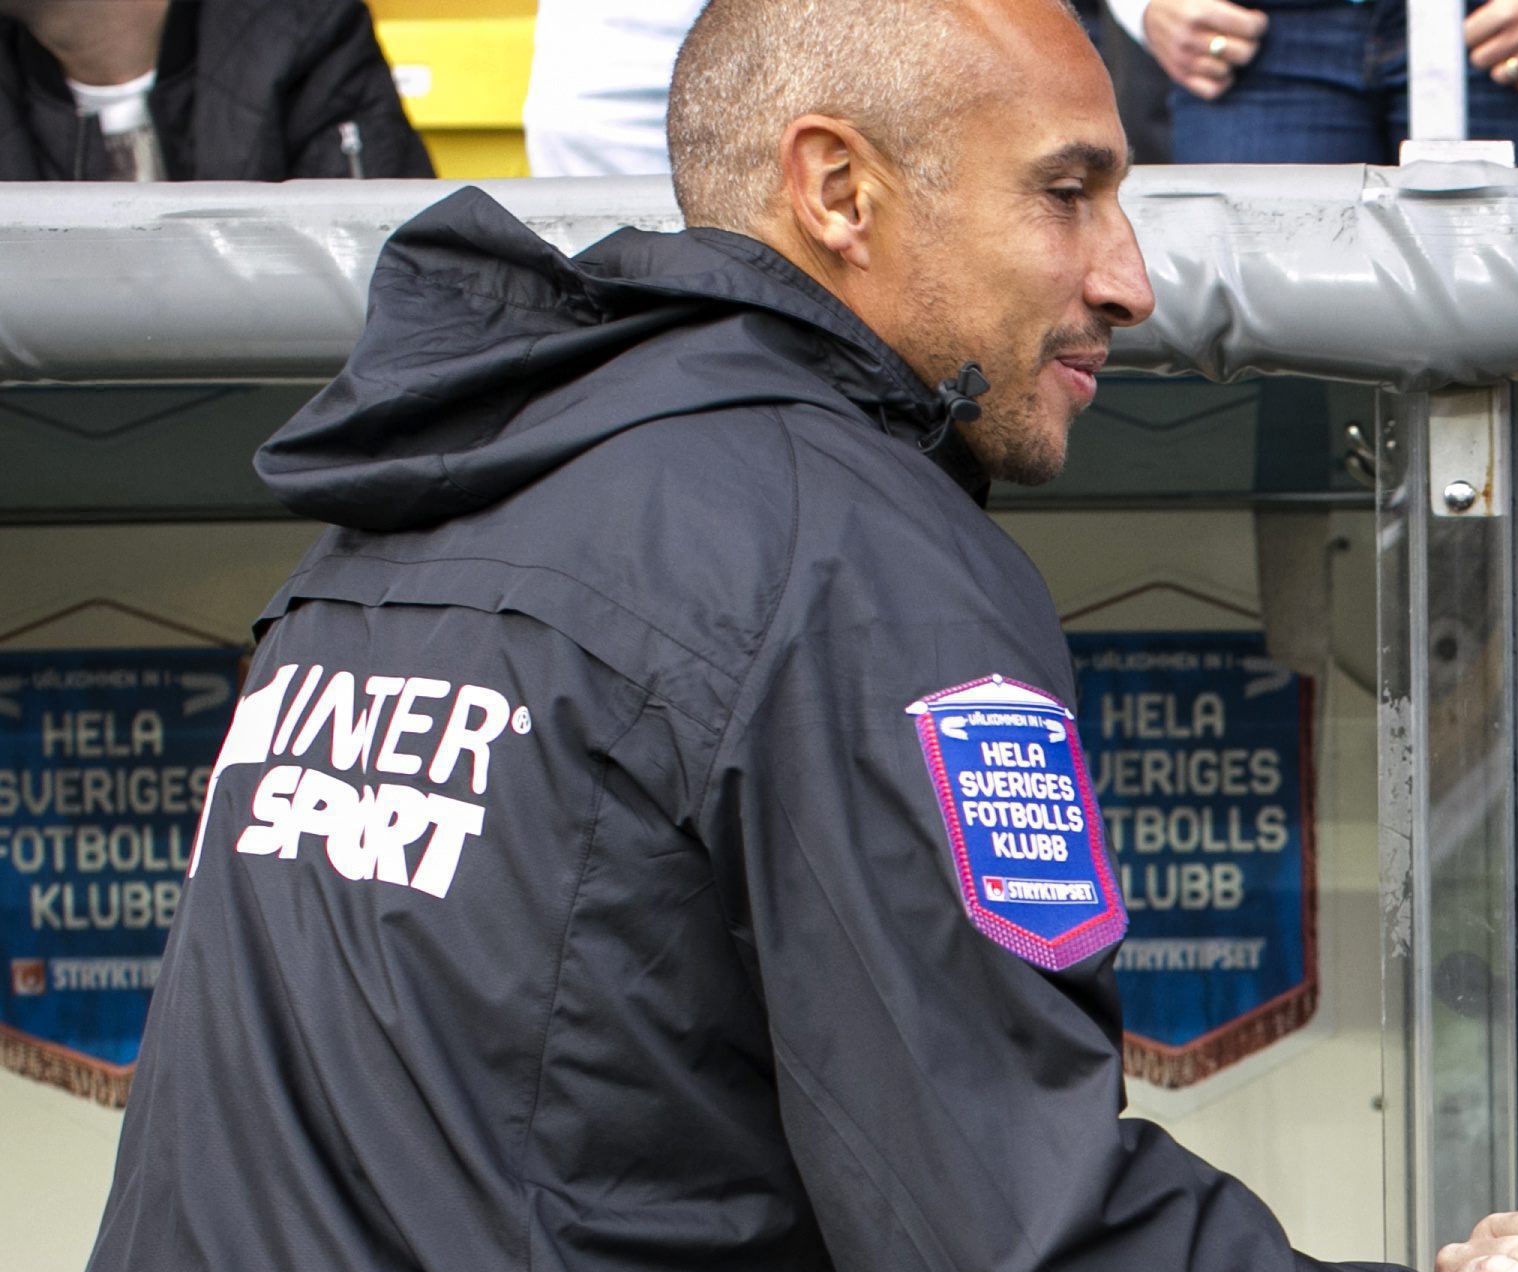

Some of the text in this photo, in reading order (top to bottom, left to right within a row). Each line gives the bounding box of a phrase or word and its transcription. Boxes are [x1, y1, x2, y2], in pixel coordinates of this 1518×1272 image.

[42, 710, 164, 758] HELA
[1101, 692, 1226, 740] HELA
[980, 741, 1046, 768] HELA
[1087, 748, 1282, 797] VERIGES
[958, 770, 1075, 801] SVERIGES
[962, 801, 1084, 833] FOTBOLLS
[1103, 804, 1289, 854] TBOLLS
[0, 824, 190, 875] OTBOLL
[991, 831, 1069, 862] KLUBB
[30, 880, 182, 931] KLUBB
[1007, 881, 1093, 901] STRYKTIPSET
[1121, 861, 1246, 911] LUBB
